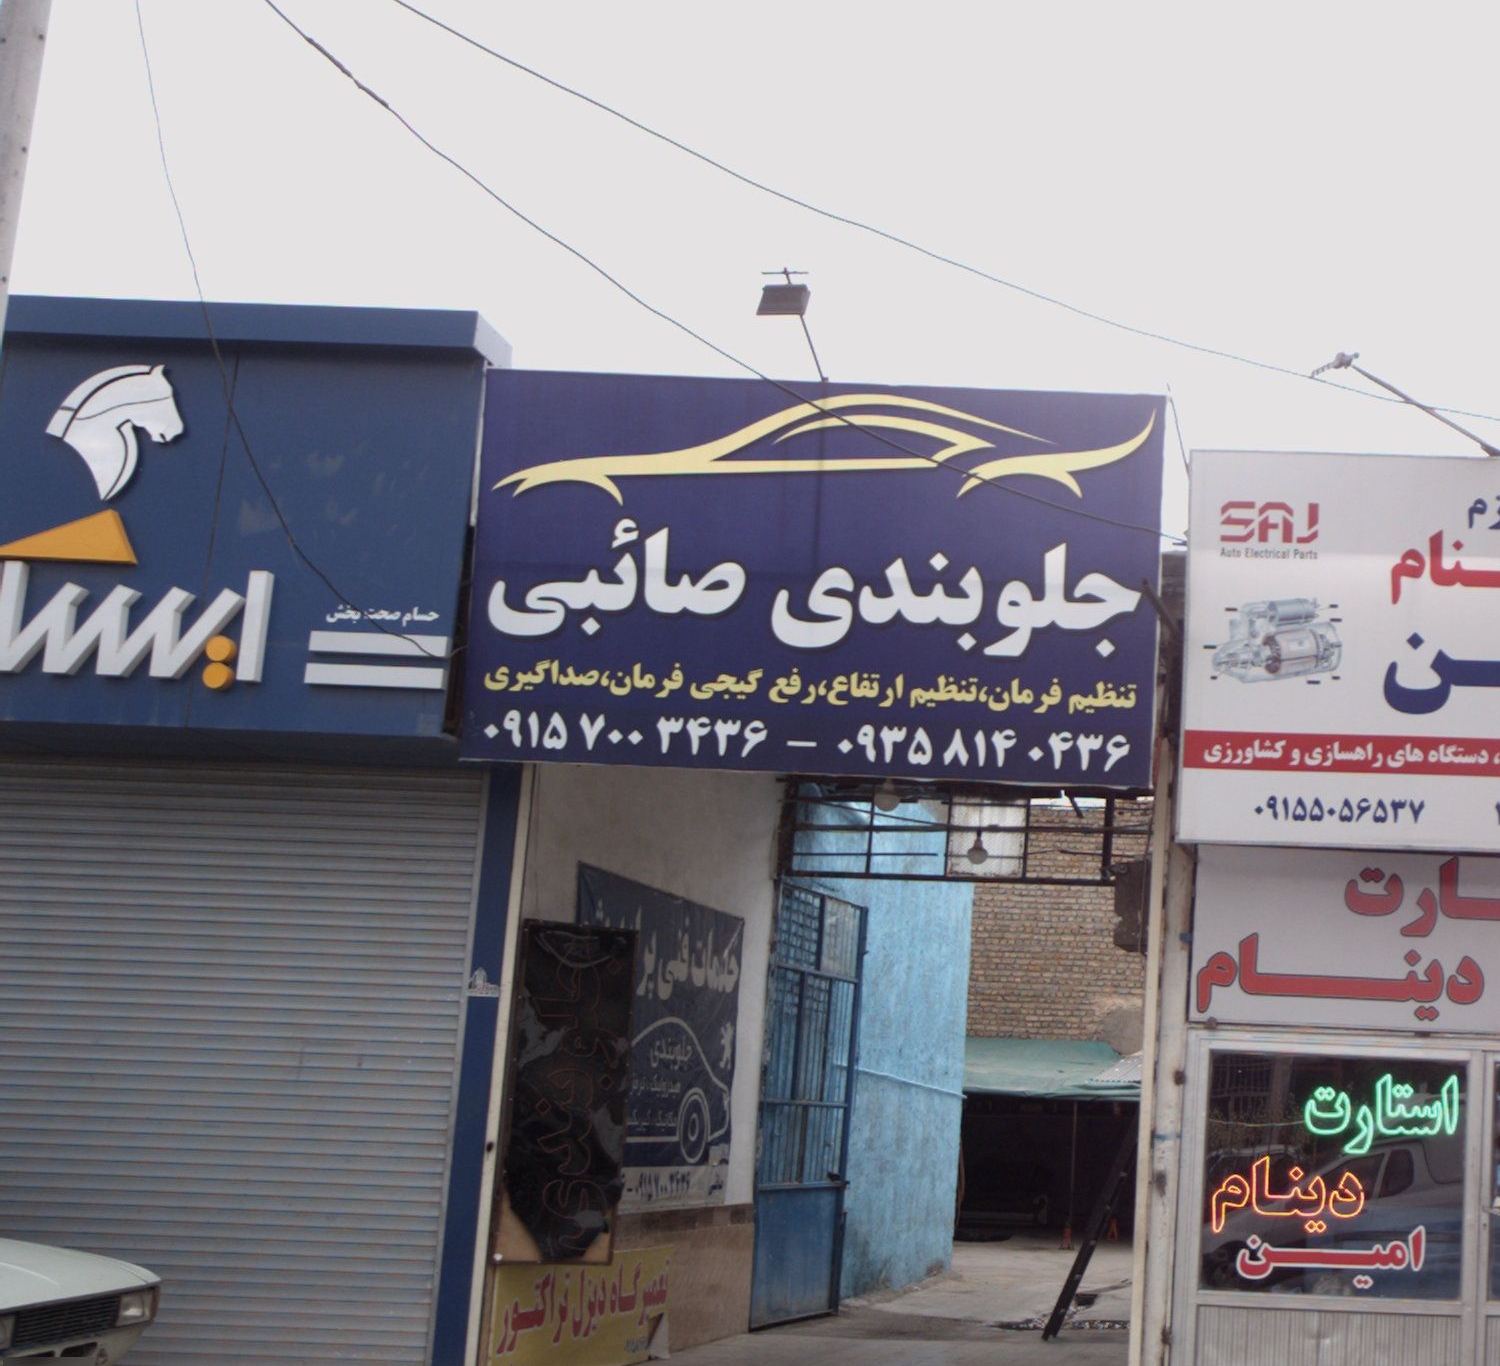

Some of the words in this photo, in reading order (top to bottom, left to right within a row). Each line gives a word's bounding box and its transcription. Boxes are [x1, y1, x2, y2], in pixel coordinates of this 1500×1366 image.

[1220, 501, 1319, 543] SAJ
[1220, 547, 1242, 558] Auto
[1244, 548, 1290, 559] Electrical
[1293, 549, 1318, 560] Parts
[487, 518, 746, 637] صائبی
[771, 543, 1143, 657] جلوبندی
[402, 606, 440, 627] حسام
[690, 669, 763, 700] گیجی
[1068, 680, 1137, 714] تنظیم
[484, 709, 566, 750] ۰۹۱۵
[580, 715, 643, 747] ۷۰۰
[656, 716, 768, 757] ۳۴۳۶
[838, 723, 931, 765] ۰۹۳۵
[942, 727, 1017, 768] ۸۱۴
[1027, 731, 1131, 772] ۰۴۳۶
[1203, 738, 1287, 765] کشاورزی
[1303, 740, 1383, 767] راهسازی
[1386, 743, 1424, 767] های
[1428, 744, 1490, 764] دستگاه
[1289, 749, 1300, 766] و
[1254, 795, 1425, 824] ۰۹۱۵۵۰۵۶۵۳۷
[1195, 932, 1485, 1022] دینام
[1304, 1072, 1459, 1154] استارت
[1211, 1155, 1365, 1234] دینام
[1236, 1225, 1427, 1289] امین
